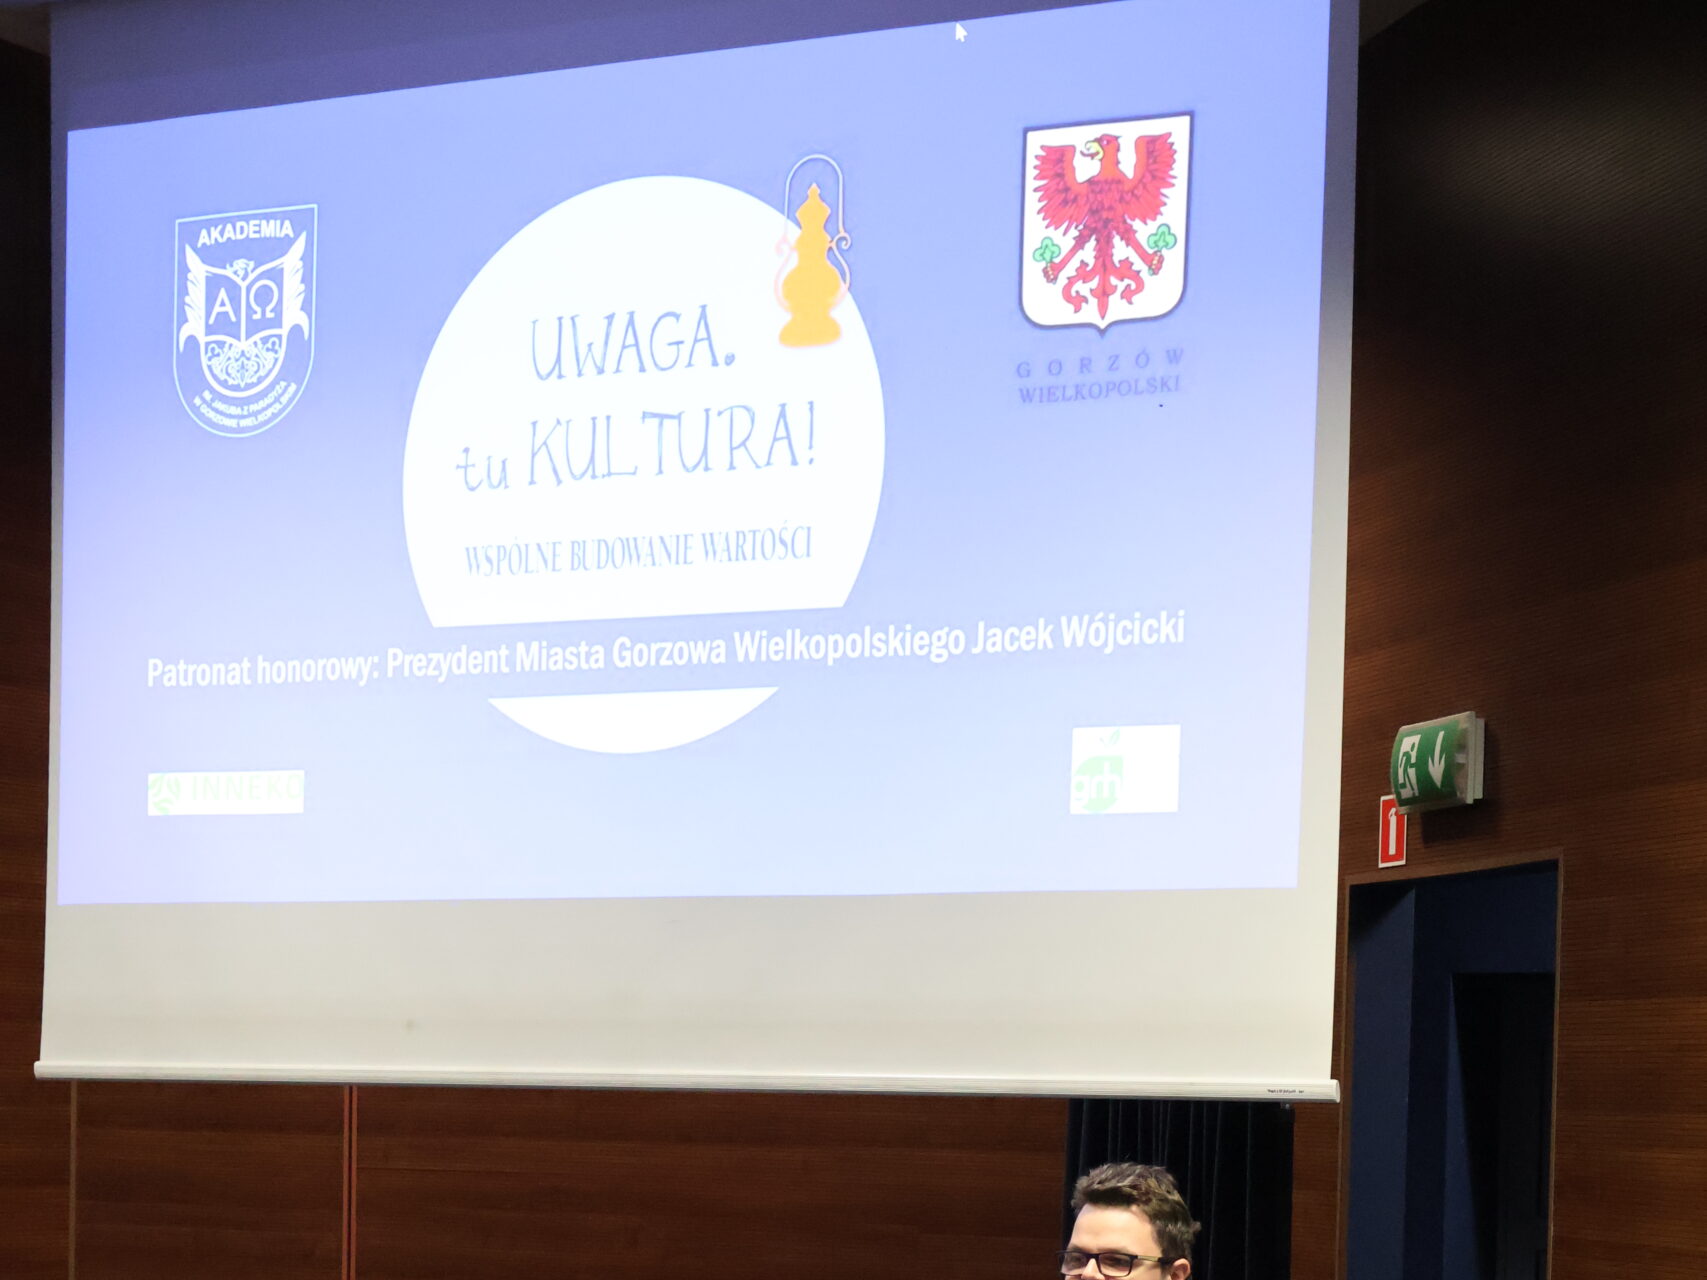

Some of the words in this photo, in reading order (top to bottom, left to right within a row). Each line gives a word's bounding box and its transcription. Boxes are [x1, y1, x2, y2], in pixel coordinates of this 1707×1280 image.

[197, 219, 294, 248] AKADEMIA
[249, 279, 279, 320] Ω
[530, 304, 735, 381] UWAGA.
[1016, 346, 1184, 378] GORZÓW
[1018, 375, 1180, 403] WIELKOPOLSKI
[456, 446, 509, 492] tu
[528, 400, 814, 487] KULTURA!
[465, 536, 562, 577] WSPÓLNE
[569, 532, 694, 572] BUDOWANIE
[701, 519, 813, 563] WARTOŚCI
[147, 657, 251, 687] Patronat
[257, 653, 380, 687] honorowy:
[386, 644, 509, 683] Prezydent
[515, 639, 605, 673] Miasta
[612, 635, 726, 669] Gorzowa
[733, 623, 965, 667] Wielkopolskiego
[971, 616, 1053, 655] Jacek
[1060, 609, 1185, 655] Wójcicki
[190, 773, 304, 801] INNEKO
